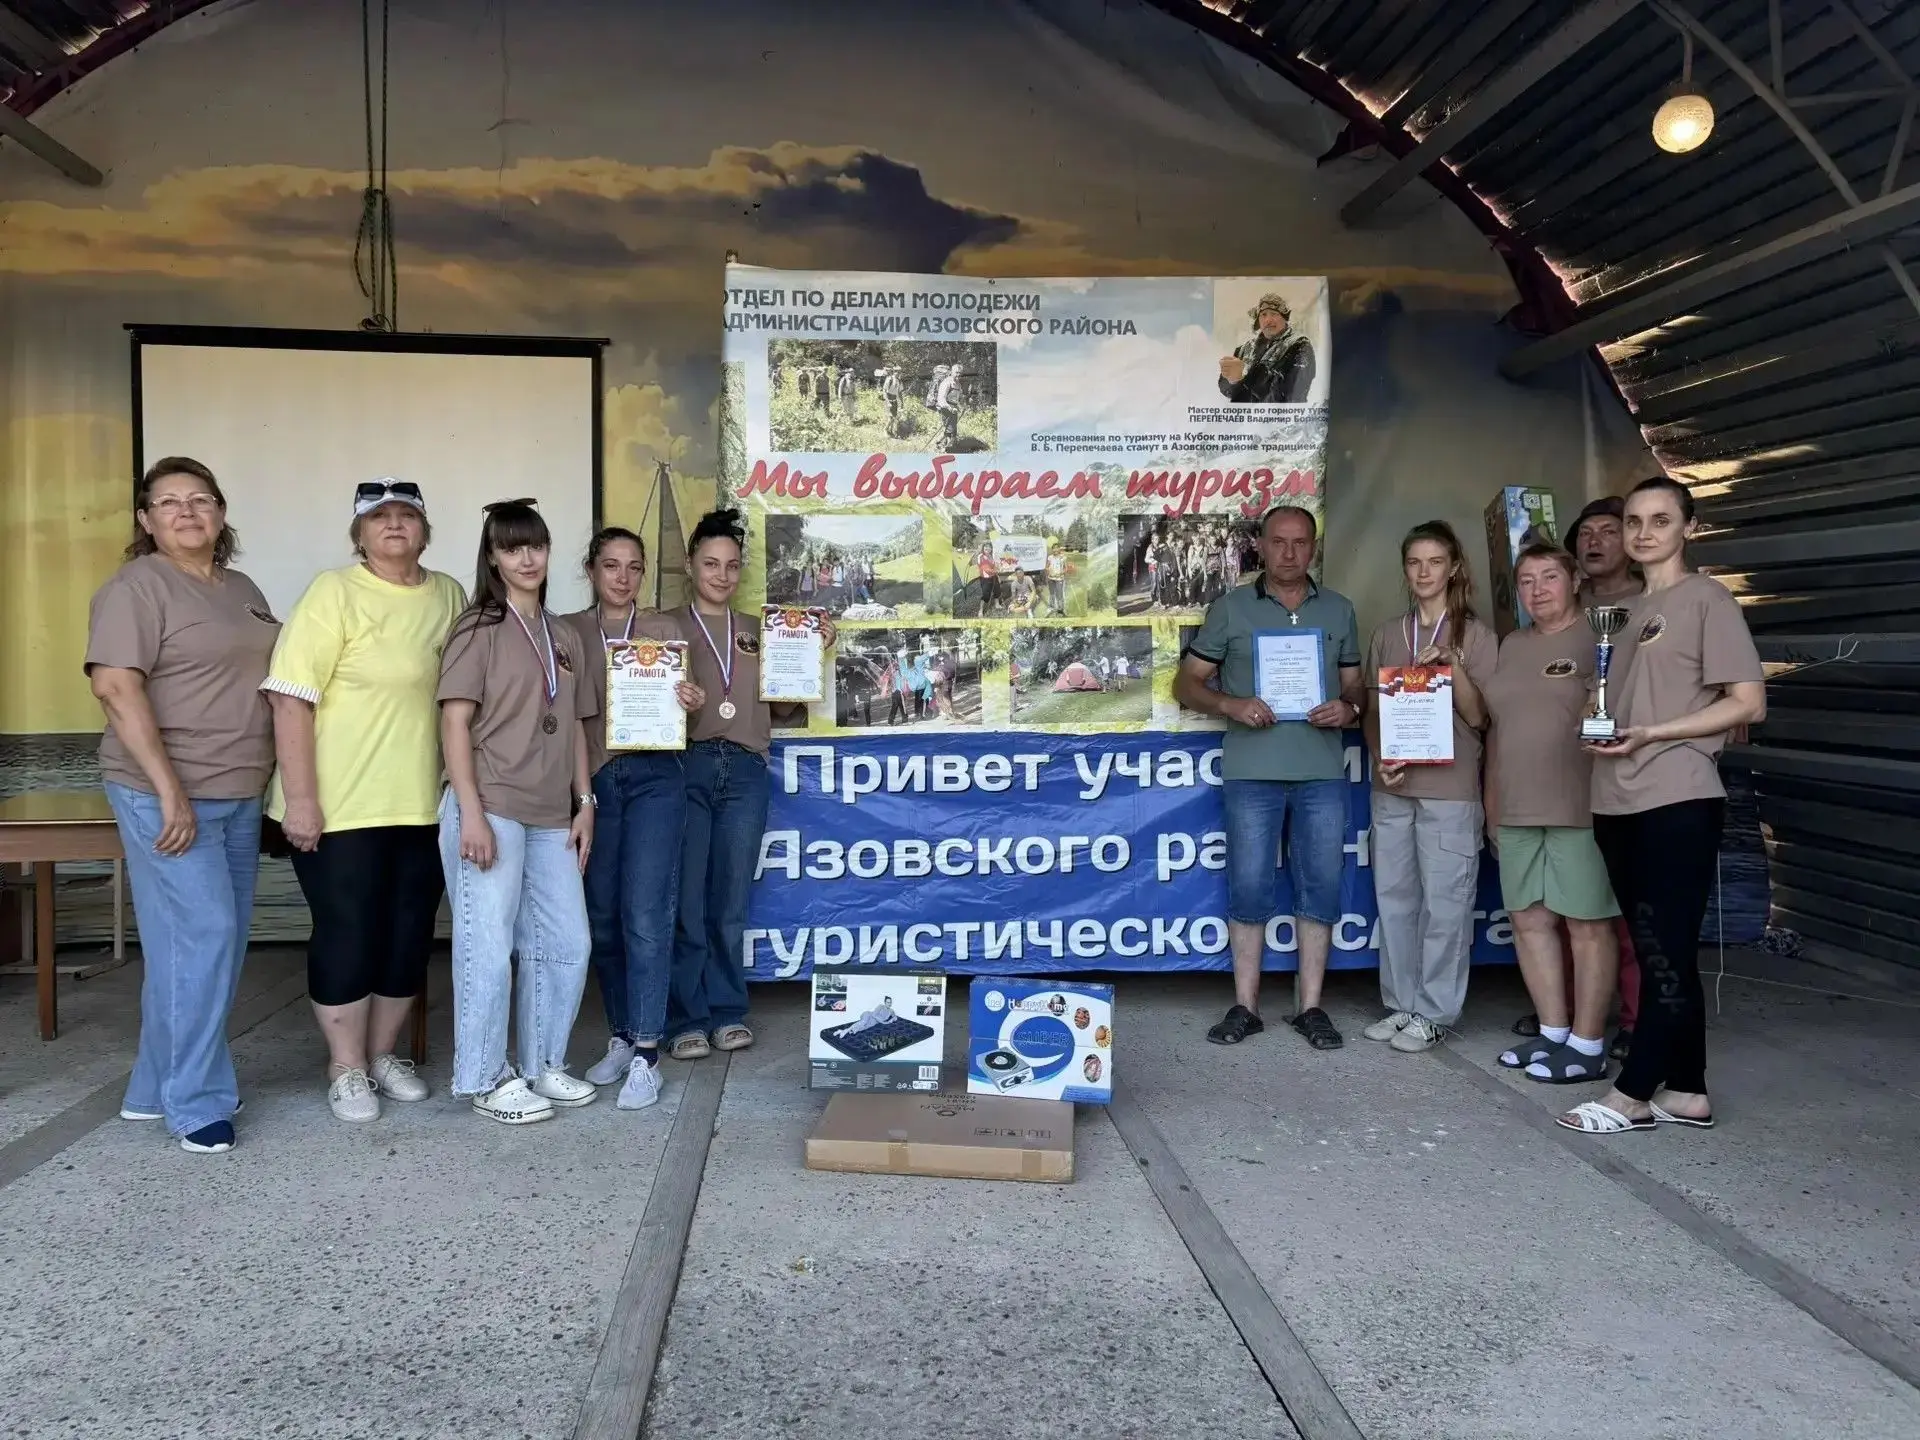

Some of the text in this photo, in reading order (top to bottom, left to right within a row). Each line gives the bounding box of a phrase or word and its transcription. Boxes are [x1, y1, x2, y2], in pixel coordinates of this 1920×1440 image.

[792, 290, 825, 307] ПО
[831, 291, 905, 310] ДЕЛАМ
[912, 293, 1041, 313] МОЛОДЕЖИ
[917, 317, 1043, 334] АЗОВСКОГО
[1050, 316, 1138, 335] РАЙОНА
[1188, 407, 1220, 415] Мастер
[1223, 407, 1251, 416] спорта
[1268, 407, 1305, 416] горному
[1189, 415, 1245, 423] ПЕРЕПЕЧАЕВ
[1247, 415, 1291, 424] Владимир
[1031, 433, 1105, 444] Соревнования
[1124, 435, 1167, 444] туризму
[1184, 432, 1215, 442] Кубок
[1218, 434, 1254, 442] памяти
[1031, 443, 1041, 452] В.
[1043, 443, 1053, 452] Б.
[1056, 443, 1124, 453] Перепечаева
[1126, 443, 1159, 453] станут
[1171, 442, 1219, 451] Азовском
[1221, 443, 1259, 452] районе
[736, 452, 1317, 518] Мы выбираем туризм
[778, 628, 809, 640] ГРАМОТА
[628, 667, 667, 679] ГРАМОТА
[783, 746, 1050, 804] Привет
[753, 829, 1131, 881] Азовского
[493, 1109, 523, 1120] crocs
